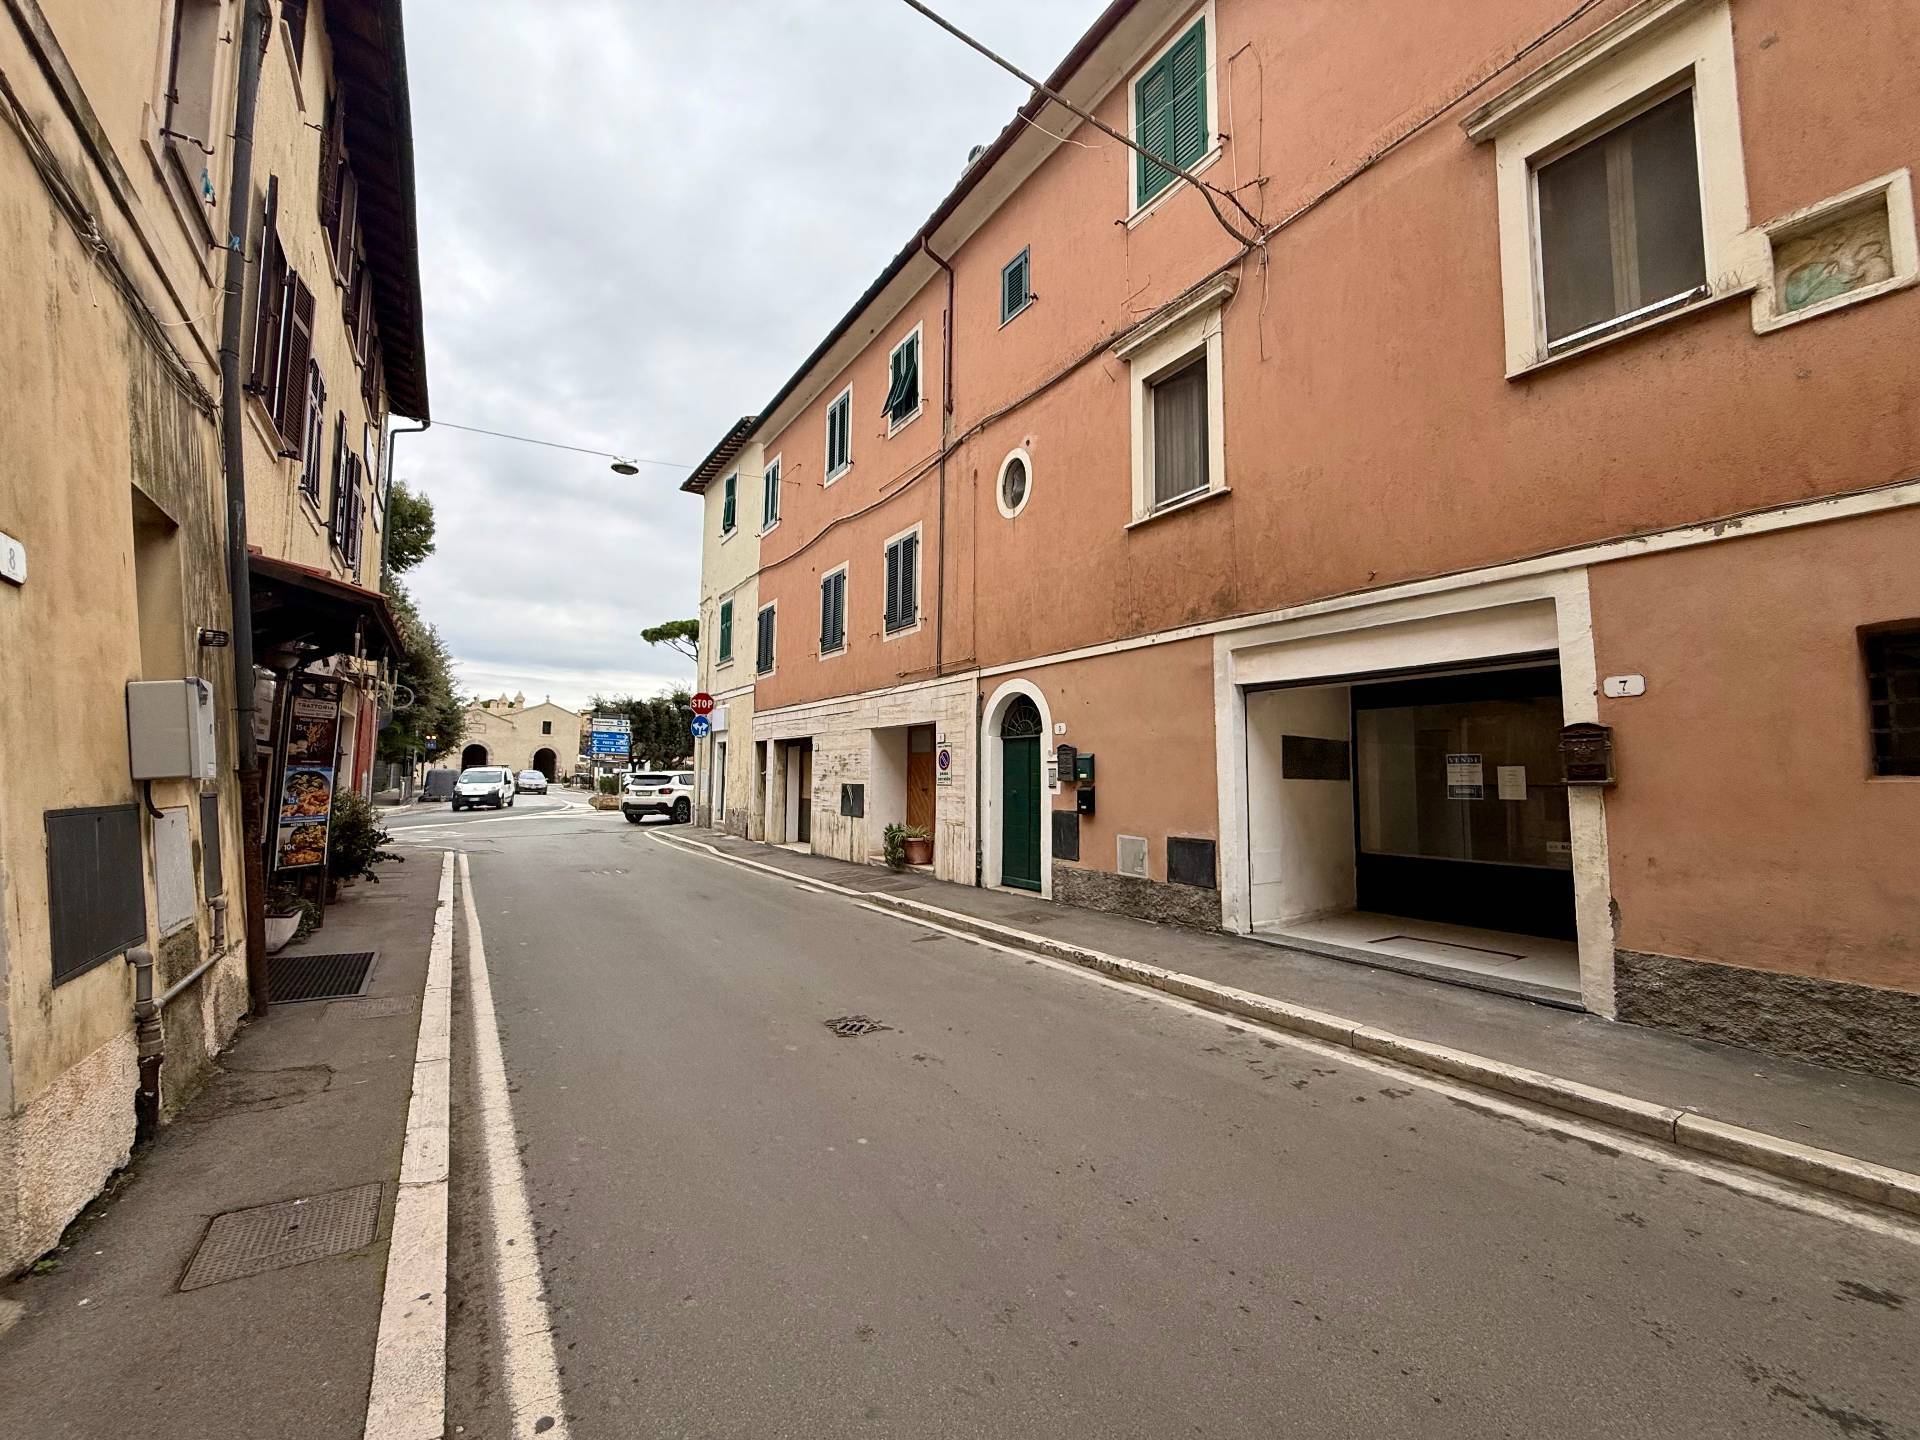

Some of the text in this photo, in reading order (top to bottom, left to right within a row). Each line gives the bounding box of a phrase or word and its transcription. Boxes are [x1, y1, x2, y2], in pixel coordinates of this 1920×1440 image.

[9, 547, 16, 571] 8
[1618, 679, 1628, 691] 7
[298, 702, 335, 711] TRATTORIA
[691, 699, 713, 708] STOP
